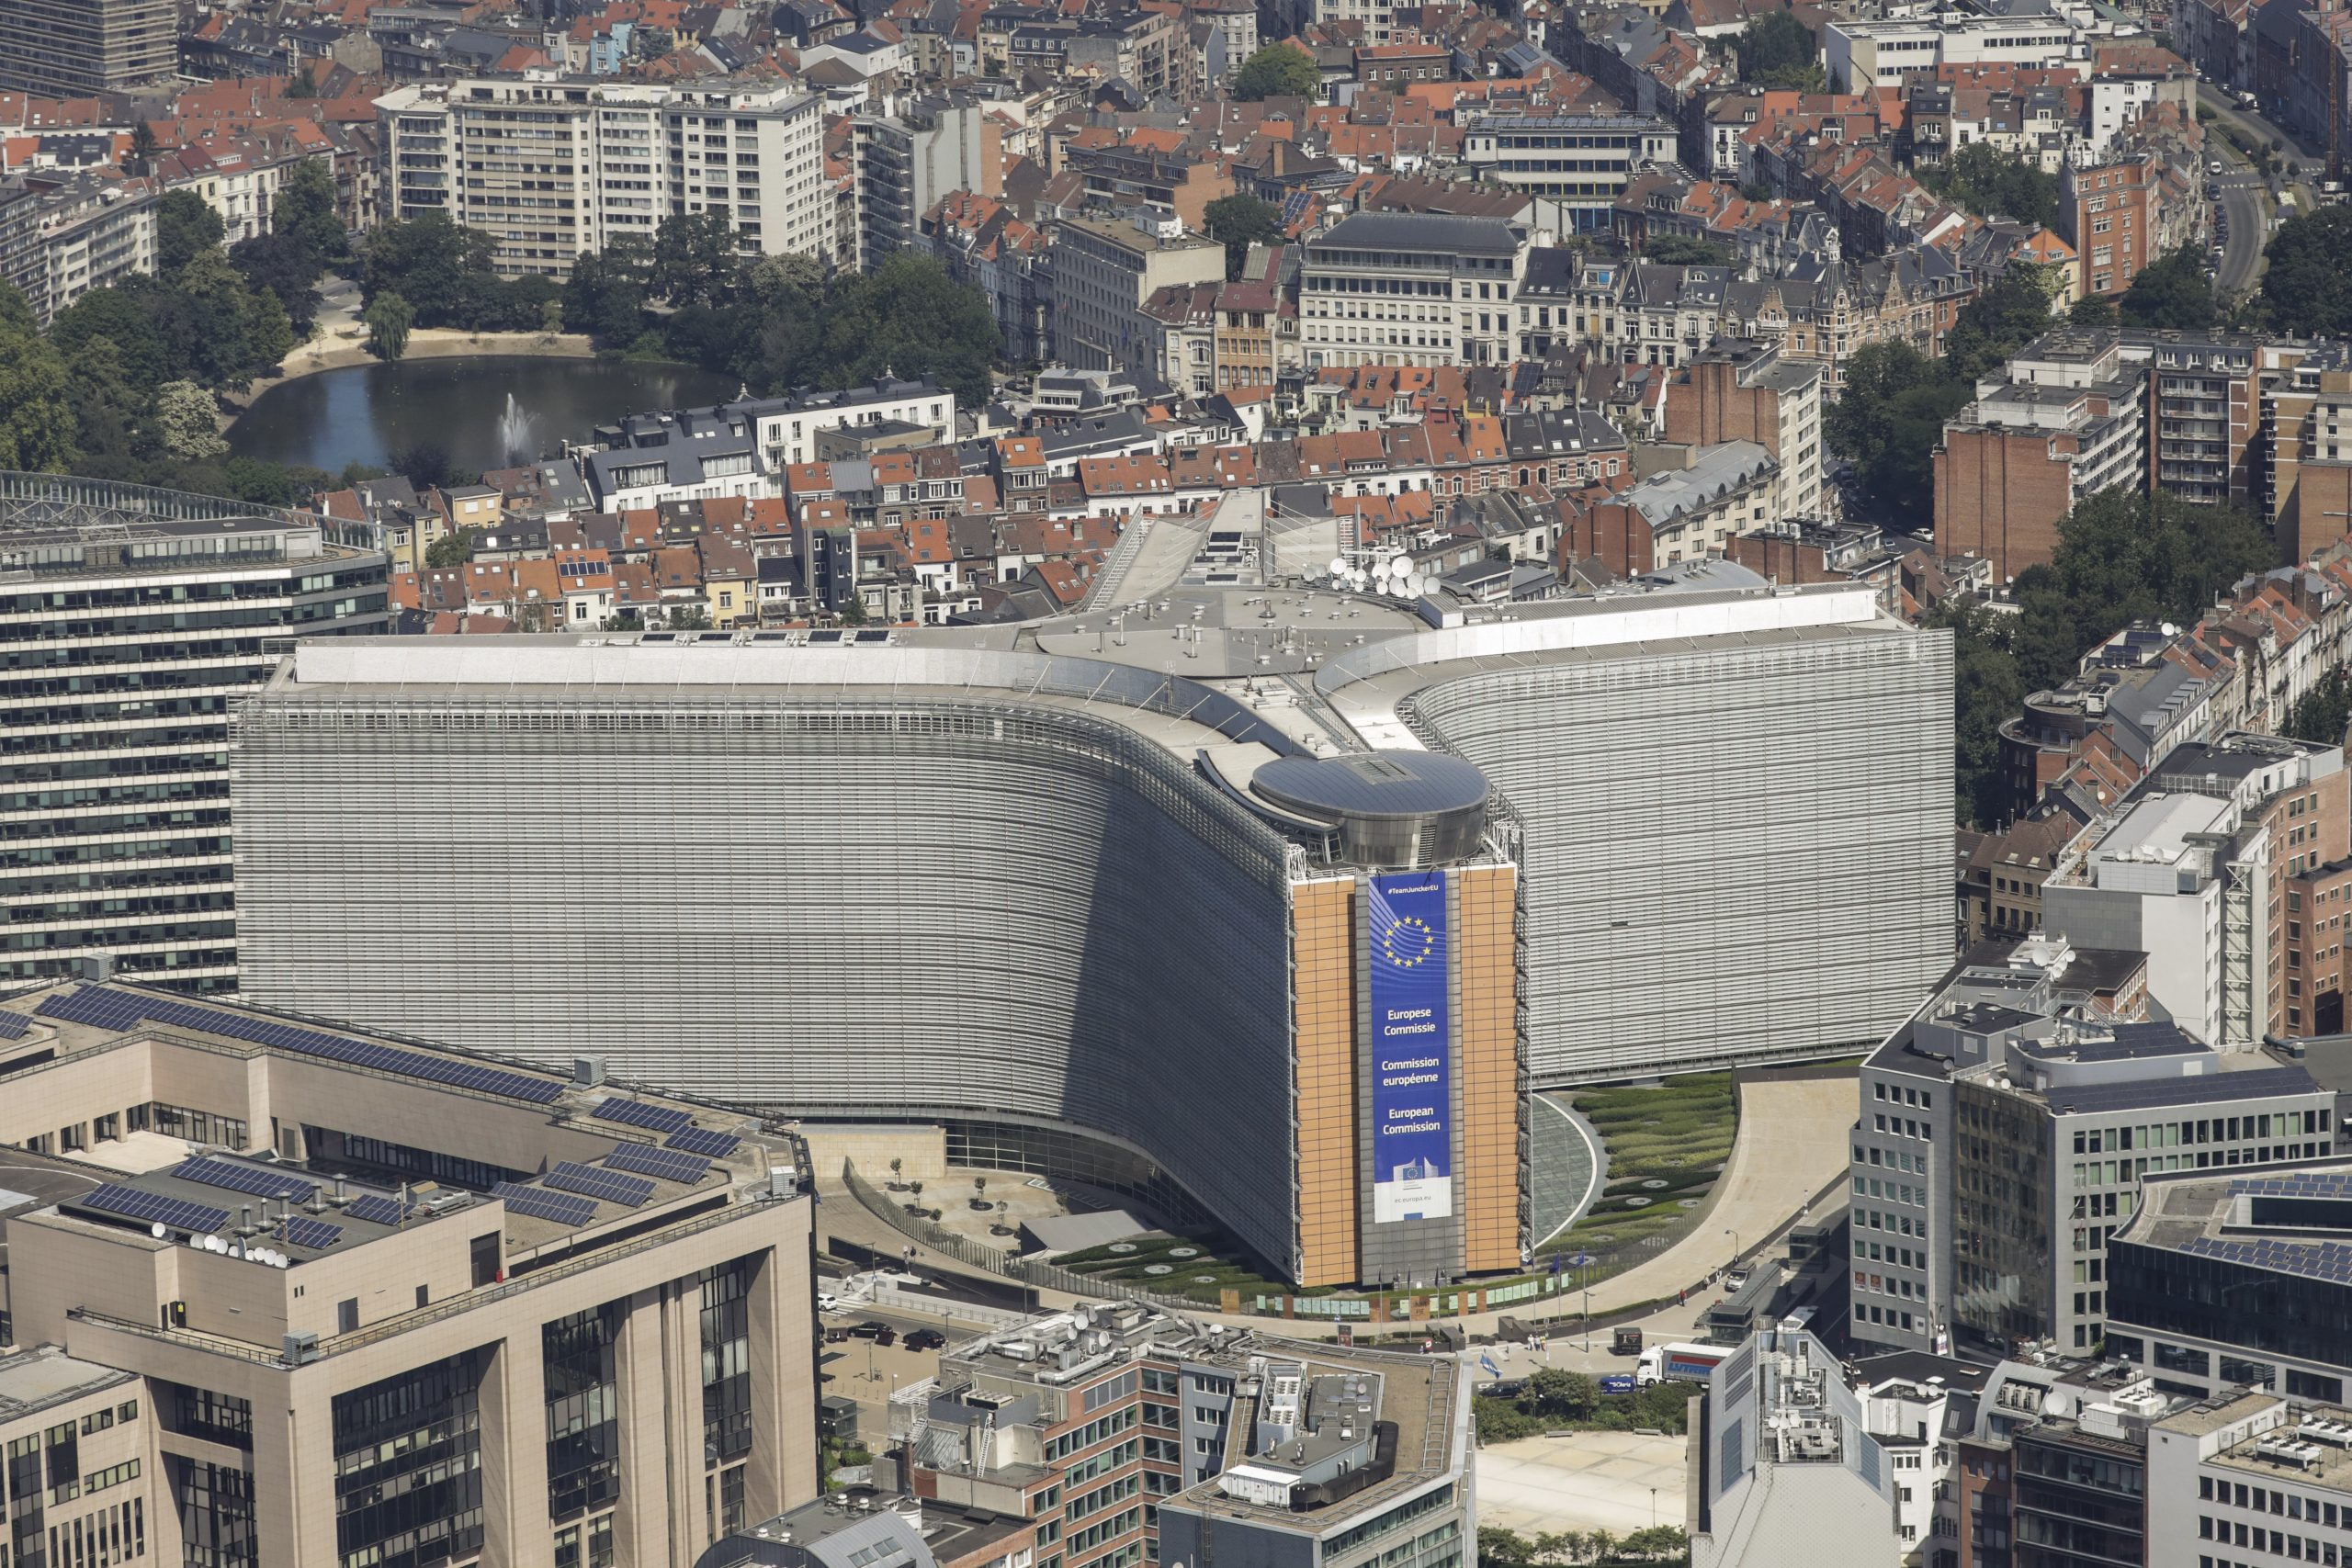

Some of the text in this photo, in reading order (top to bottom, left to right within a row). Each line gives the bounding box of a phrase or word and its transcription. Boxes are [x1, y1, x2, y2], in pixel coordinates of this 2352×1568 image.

[1388, 885, 1439, 895] #TeamJunckerEU
[1388, 1009, 1431, 1021] Europese
[1385, 1022, 1436, 1036] Commissie
[1382, 1057, 1440, 1071] Commission
[1383, 1073, 1439, 1087] européenne
[1389, 1107, 1434, 1119] European
[1383, 1122, 1441, 1135] Commission
[1395, 1195, 1431, 1205] ec.europa.eu
